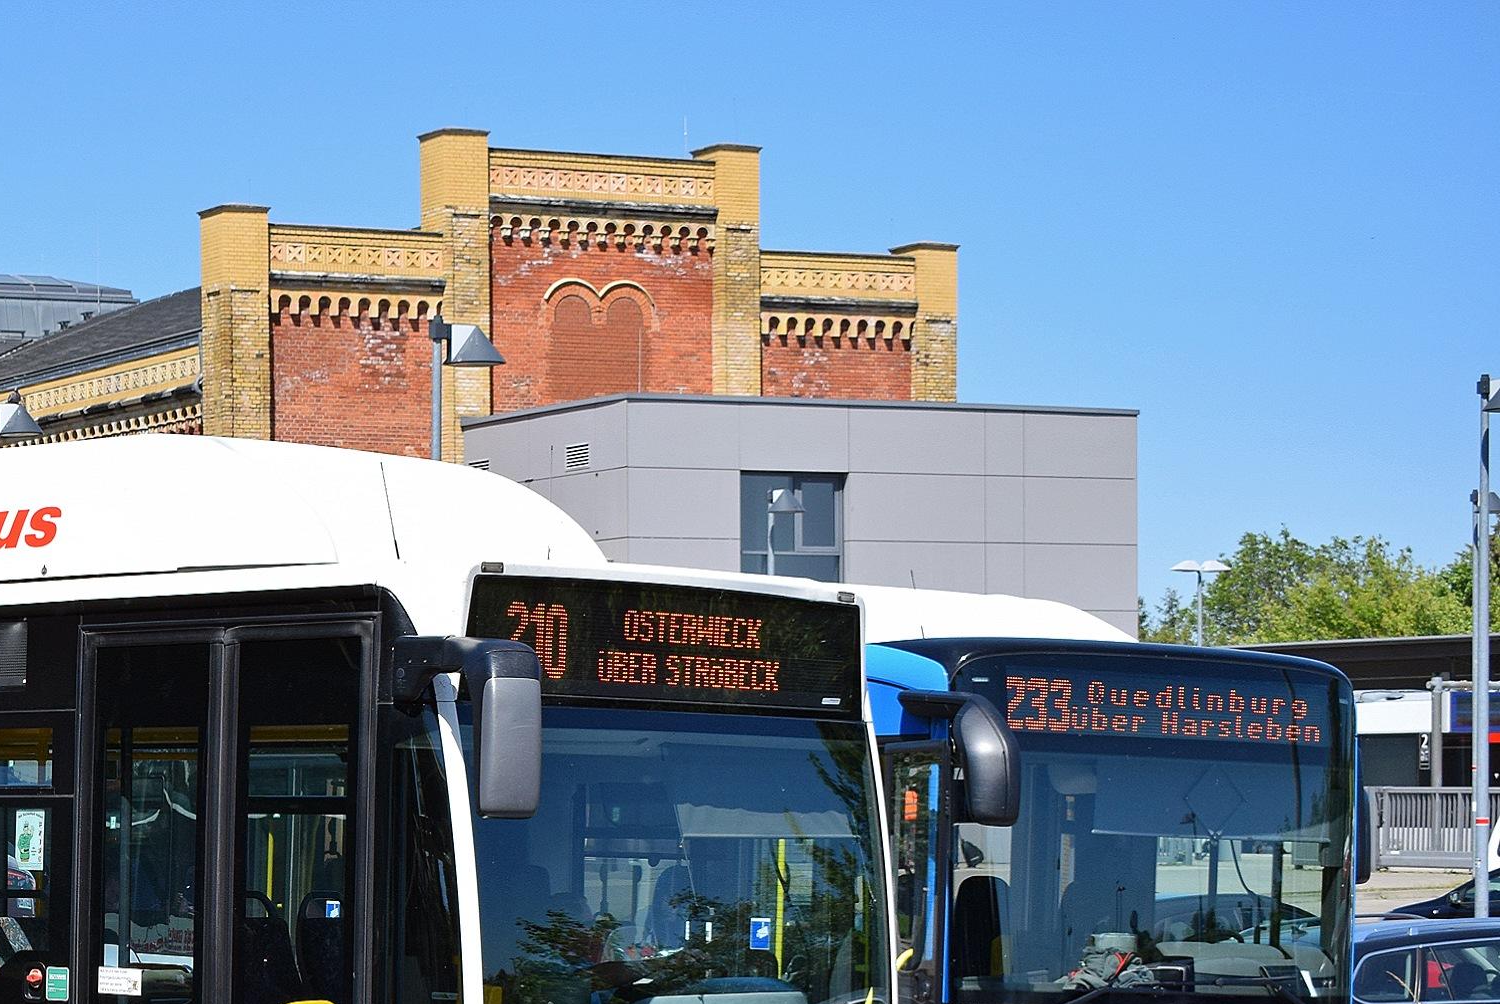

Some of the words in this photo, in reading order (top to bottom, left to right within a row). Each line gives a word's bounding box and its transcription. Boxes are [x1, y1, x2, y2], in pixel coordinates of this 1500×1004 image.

[624, 609, 763, 650] OSTERWIECK
[598, 650, 657, 686] ÜBER
[665, 653, 780, 692] STRÖBECK
[1006, 676, 1072, 733] 233
[1088, 680, 1308, 719] Quedlinburg
[1071, 706, 1146, 733] über
[1161, 712, 1321, 743] Harsleben
[1421, 733, 1429, 749] 2
